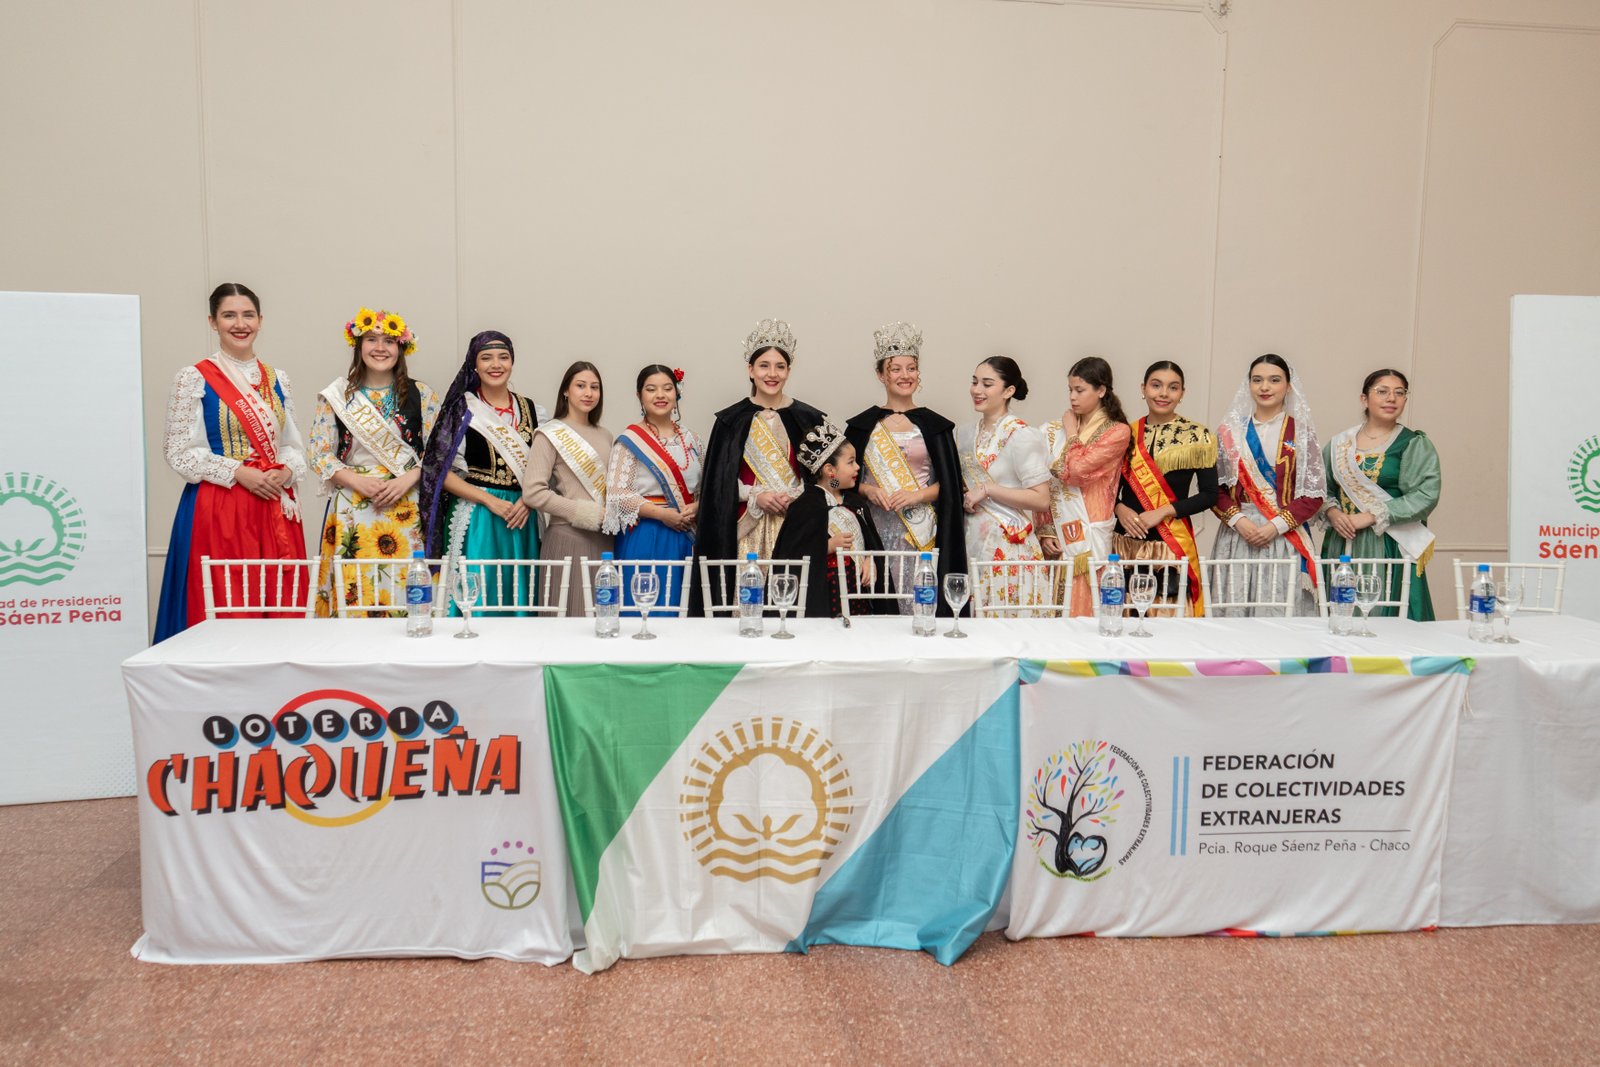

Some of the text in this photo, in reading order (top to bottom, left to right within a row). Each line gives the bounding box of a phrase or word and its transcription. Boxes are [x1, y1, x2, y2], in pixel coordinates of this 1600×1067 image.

[235, 398, 266, 442] COLECTIVIDAD
[352, 404, 403, 460] REINA
[554, 428, 597, 478] ASOCIACIÓN
[0, 607, 122, 626] Sáenz Peña
[20, 599, 38, 608] de
[42, 595, 121, 608] Presidencia
[210, 702, 451, 741] LOTERIA
[147, 726, 522, 817] CHAQUEÑA
[1203, 748, 1335, 771] FEDERACIÓN
[1109, 744, 1153, 866] FEDERACIÓN DE COLECTIVIDADES EXTRANJERAS
[1201, 780, 1406, 799] DE COLECTIVIDADES
[1200, 808, 1341, 827] EXTRANJERAS
[1199, 843, 1229, 855] Pcia.
[1234, 842, 1278, 856] Roque
[1282, 840, 1320, 853] Sáenz
[1324, 839, 1357, 852] Peña
[1370, 838, 1411, 852] Chaco
